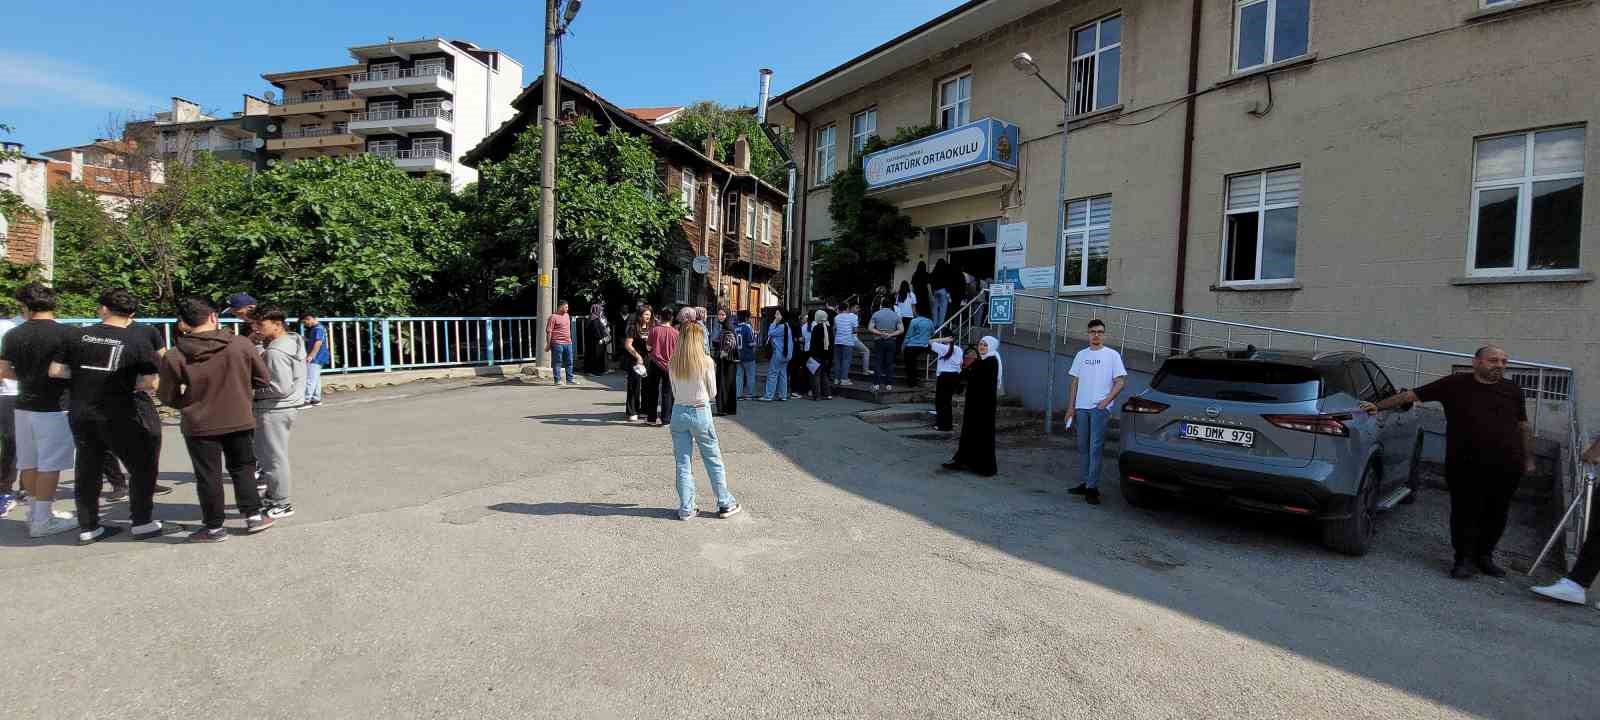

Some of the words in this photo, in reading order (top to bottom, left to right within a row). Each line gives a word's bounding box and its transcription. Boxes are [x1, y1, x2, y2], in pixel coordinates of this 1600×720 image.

[886, 158, 921, 174] ATATÜRK
[922, 142, 978, 165] ORTAOKULU
[1186, 424, 1199, 436] 06
[1205, 427, 1225, 439] DMK
[1231, 430, 1252, 443] 979
